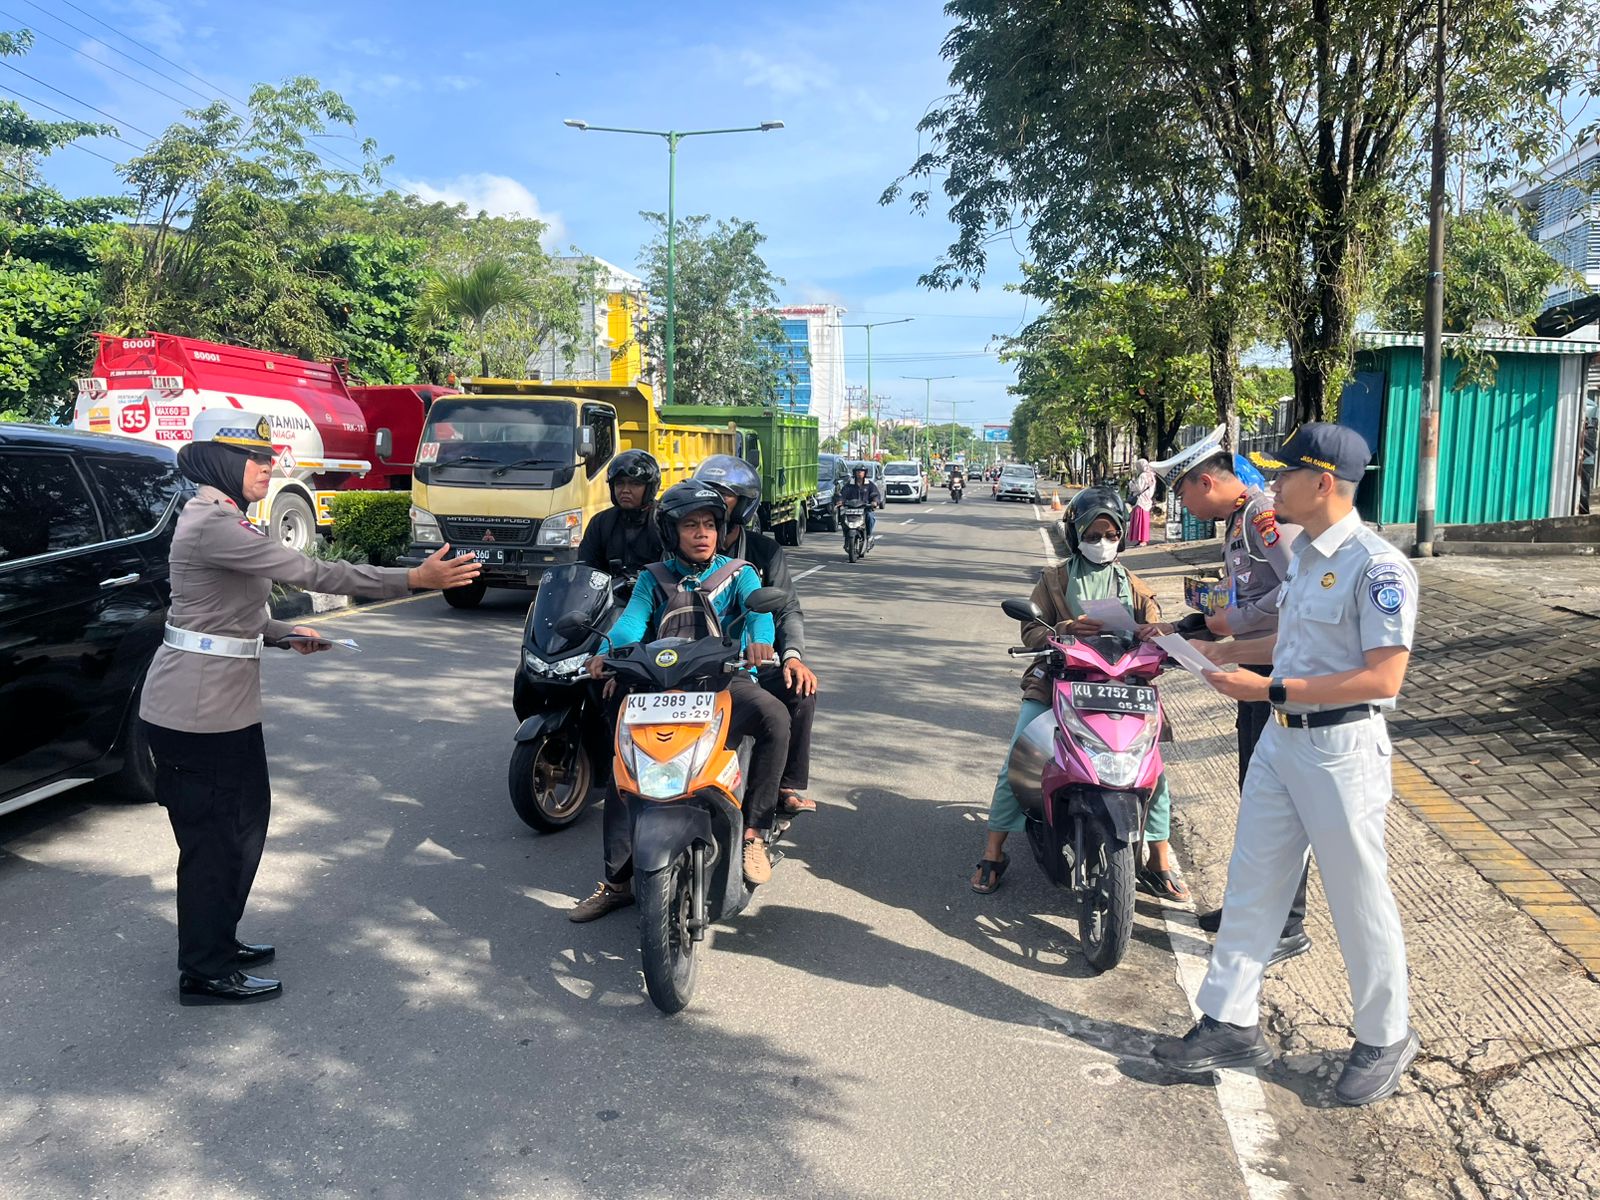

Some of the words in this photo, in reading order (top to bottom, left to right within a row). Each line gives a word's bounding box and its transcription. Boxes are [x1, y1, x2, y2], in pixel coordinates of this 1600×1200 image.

[193, 351, 220, 362] 80001
[269, 415, 312, 431] TAMINA
[157, 430, 192, 440] TRK-10
[272, 430, 296, 440] NIAGA
[422, 443, 437, 459] 60
[1300, 455, 1313, 464] JASA
[497, 550, 504, 560] G
[1074, 684, 1092, 697] KU
[1098, 686, 1130, 699] 2752
[1136, 689, 1153, 701] GT
[627, 696, 646, 709] KU
[652, 694, 687, 708] 2989
